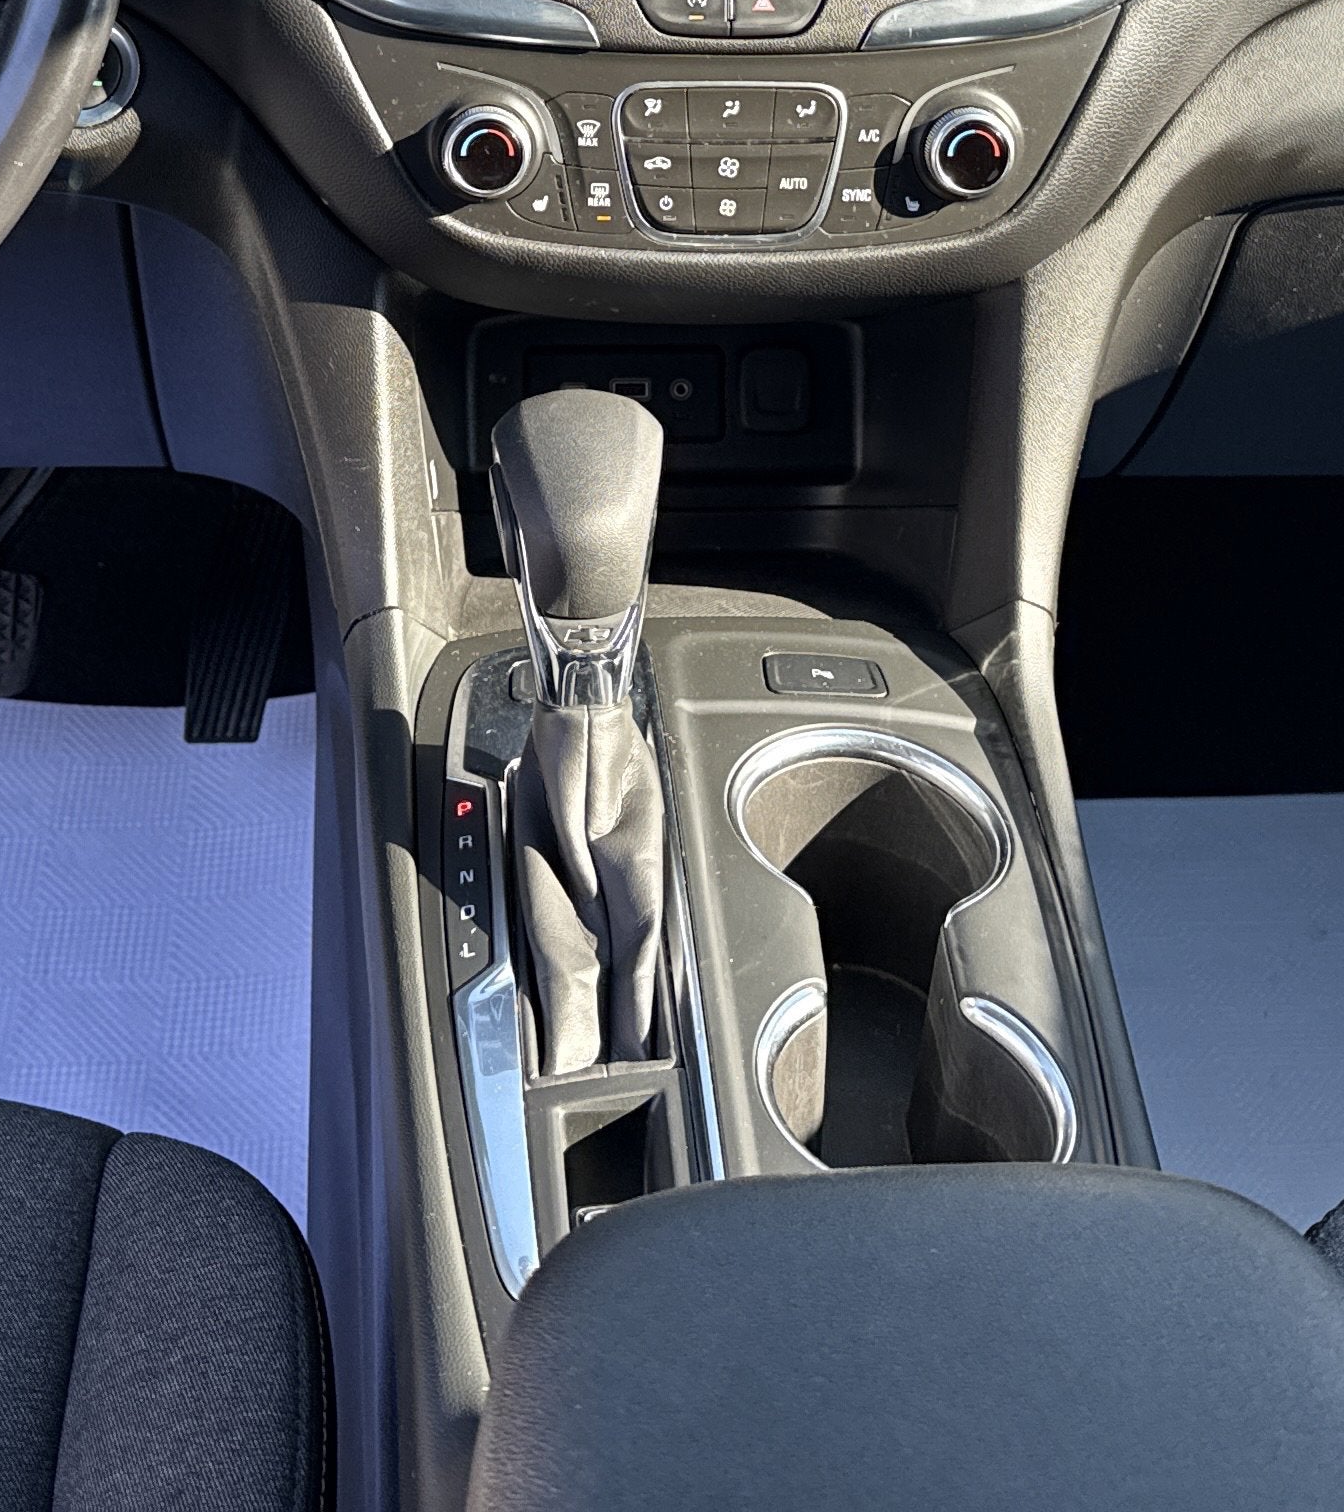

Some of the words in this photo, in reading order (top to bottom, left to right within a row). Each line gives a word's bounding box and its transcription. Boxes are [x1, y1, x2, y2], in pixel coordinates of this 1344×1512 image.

[577, 136, 599, 147] MAX
[858, 128, 880, 143] A/C
[779, 177, 808, 190] AUTO
[587, 197, 611, 207] REAR
[841, 188, 872, 202] SYNC
[457, 800, 472, 817] P
[458, 834, 473, 850] R
[459, 869, 475, 885] N
[460, 904, 476, 921] D
[460, 942, 476, 958] L
